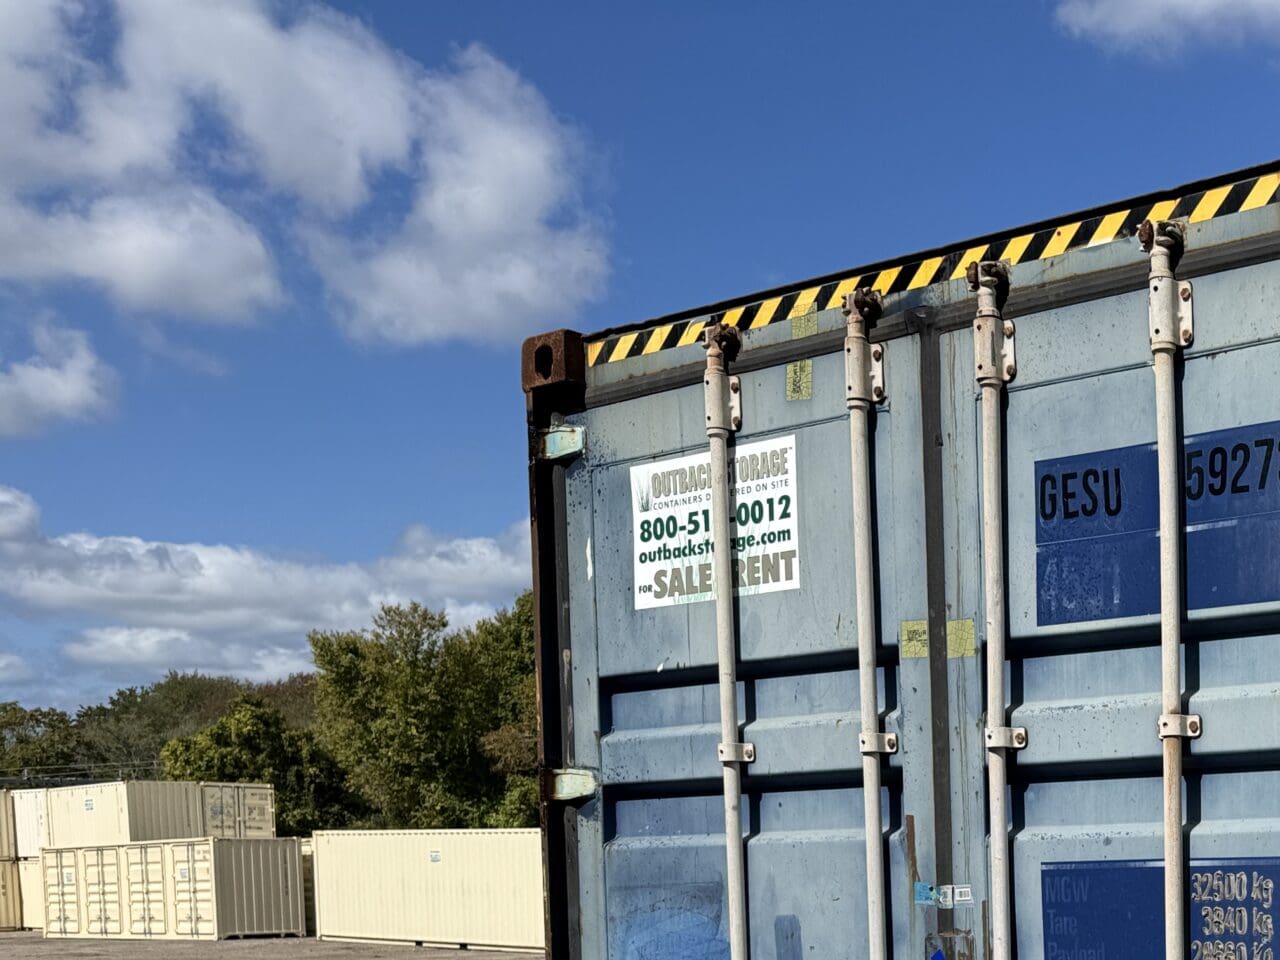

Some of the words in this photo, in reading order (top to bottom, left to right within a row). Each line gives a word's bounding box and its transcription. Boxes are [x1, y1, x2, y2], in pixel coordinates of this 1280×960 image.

[728, 448, 788, 486] TORAGE
[653, 494, 703, 511] CONTAINERS
[755, 482, 768, 493] ON
[771, 479, 790, 489] SITE
[1040, 467, 1121, 520] GESU
[640, 494, 791, 542] 800-51-0012
[638, 584, 653, 594] FOR
[653, 562, 712, 599] SALE
[731, 550, 797, 590] RENT
